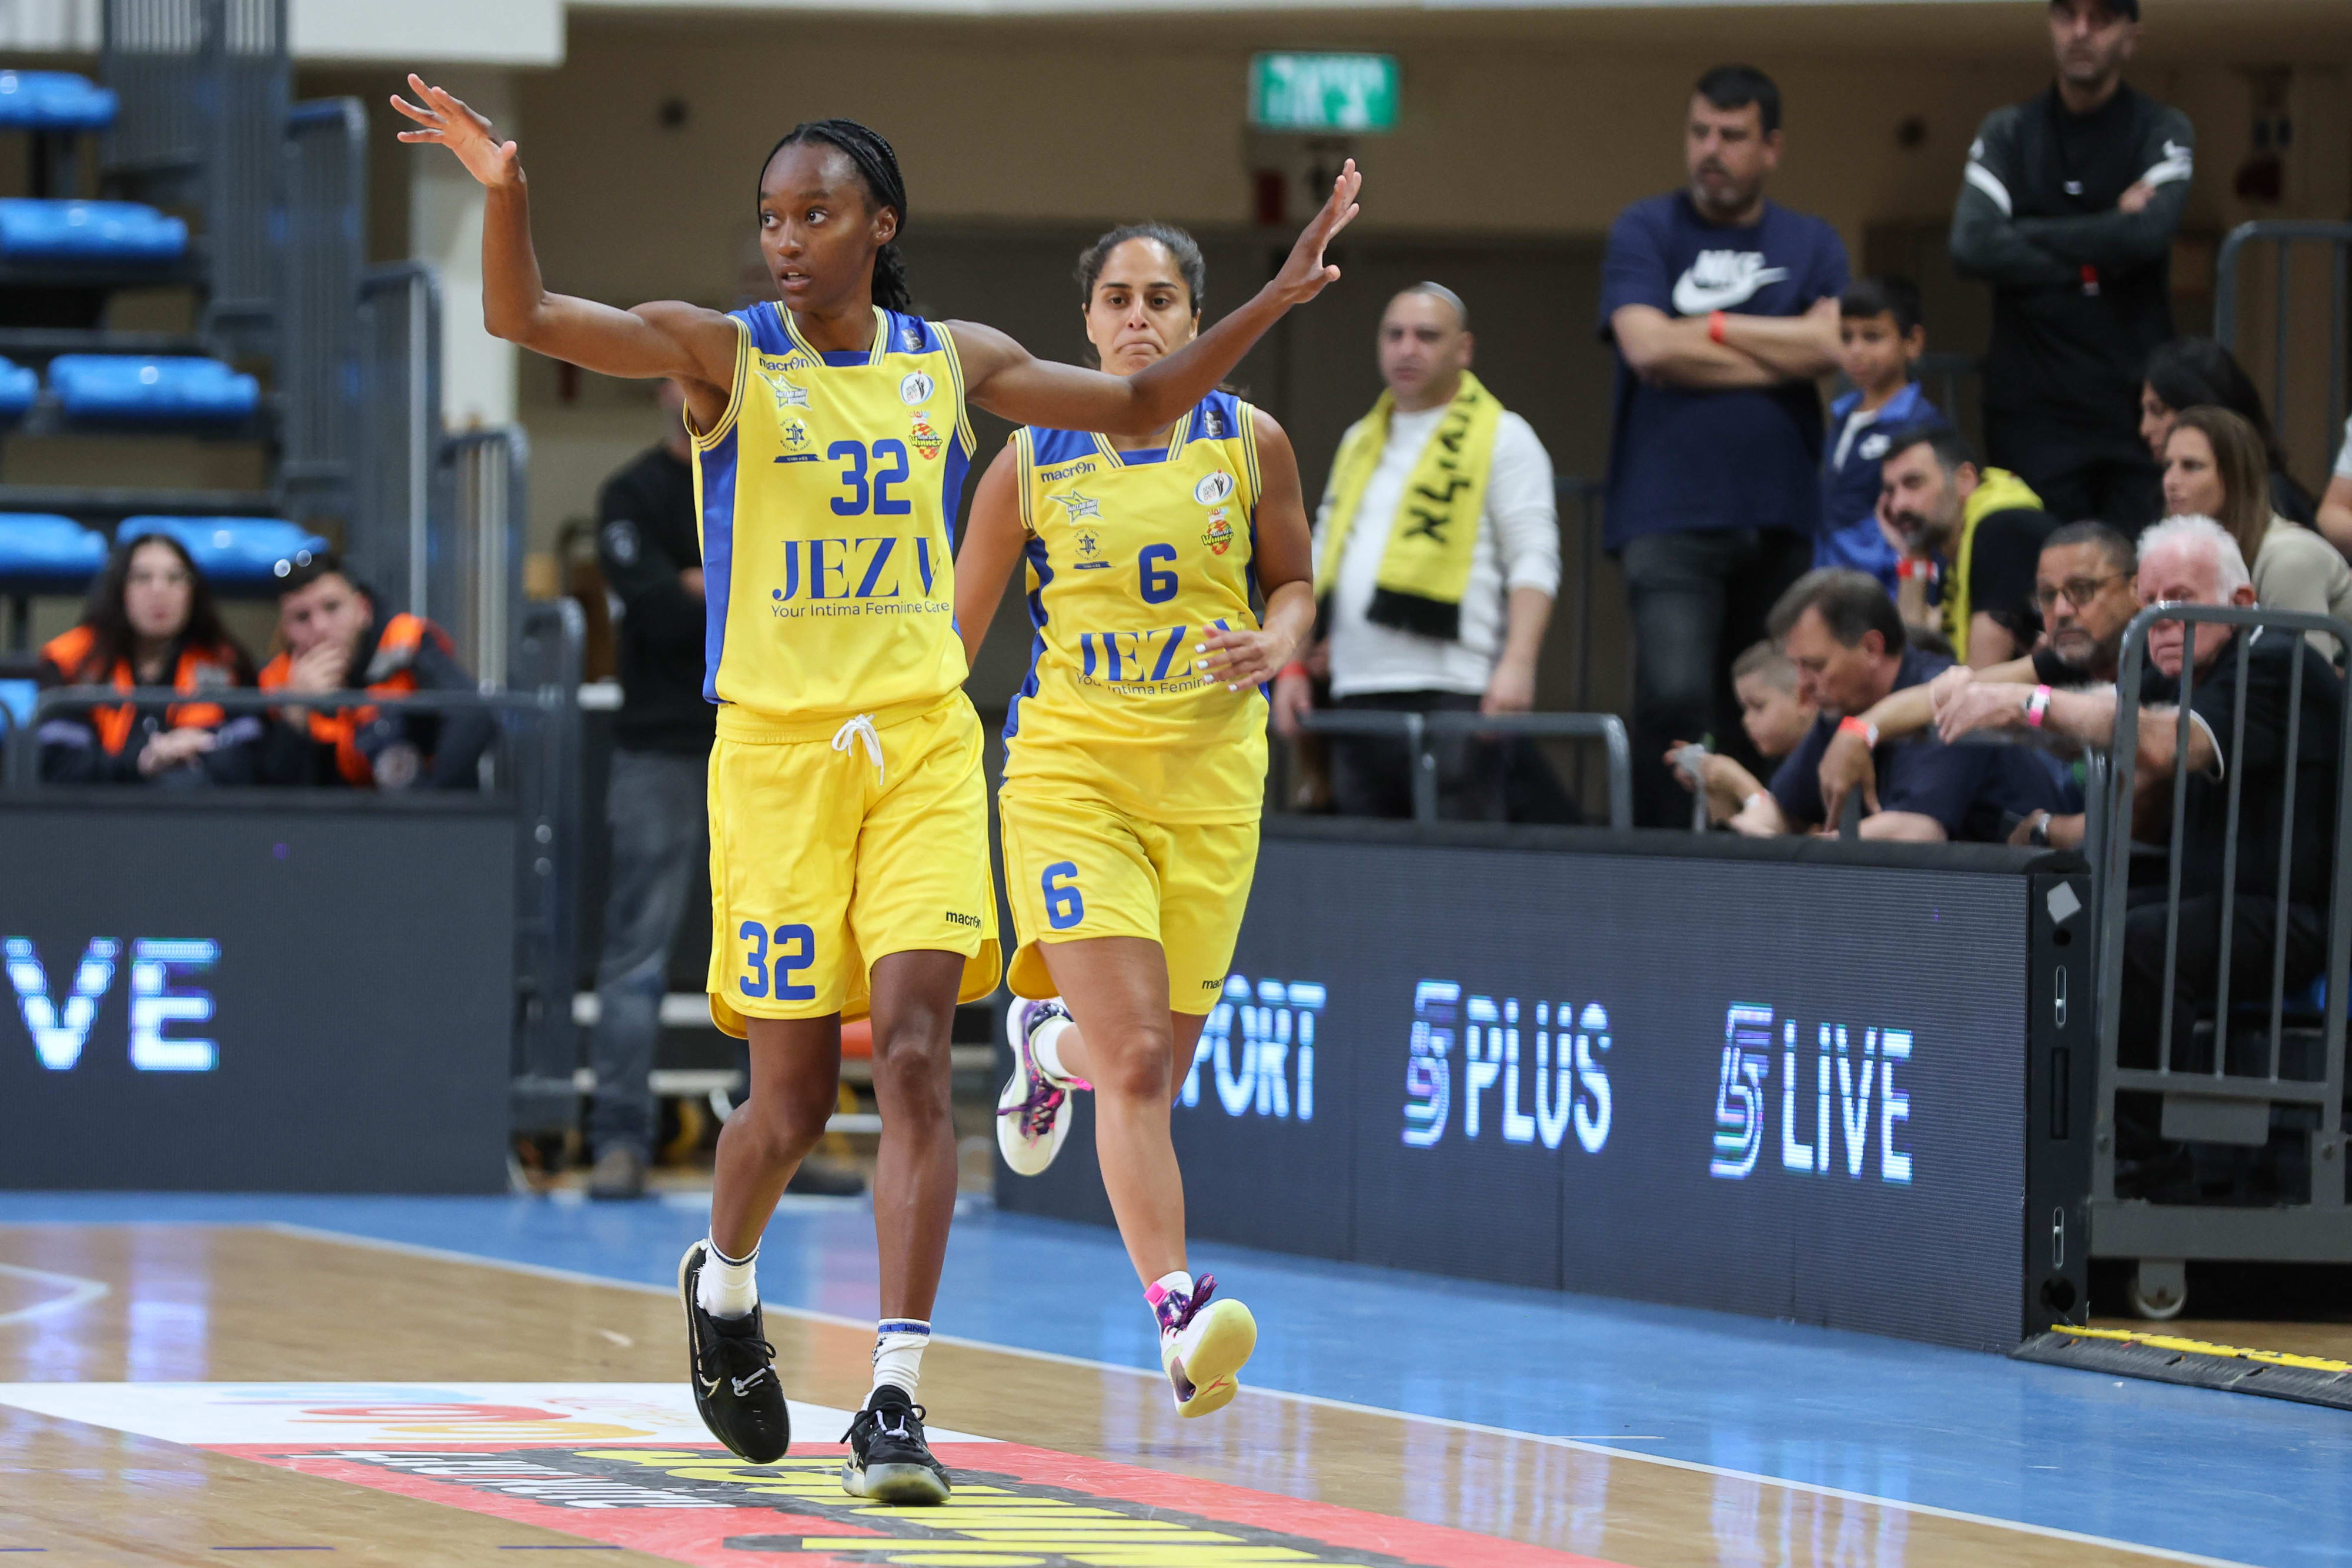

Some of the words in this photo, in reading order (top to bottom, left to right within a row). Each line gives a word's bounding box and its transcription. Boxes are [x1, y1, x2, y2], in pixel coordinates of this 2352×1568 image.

[759, 357, 810, 371] macron
[908, 435, 943, 447] Winner
[827, 438, 911, 516] 32
[1041, 462, 1096, 483] macron
[1201, 531, 1235, 546] Winner
[1138, 543, 1178, 604] 6
[771, 603, 806, 618] Your
[810, 603, 860, 616] Intima
[865, 600, 923, 615] Femiine
[924, 600, 950, 613] Care
[1041, 860, 1084, 930] 6
[739, 920, 816, 1000] 32
[1464, 995, 1612, 1154] PLUS
[1782, 1019, 1914, 1185] LIVE
